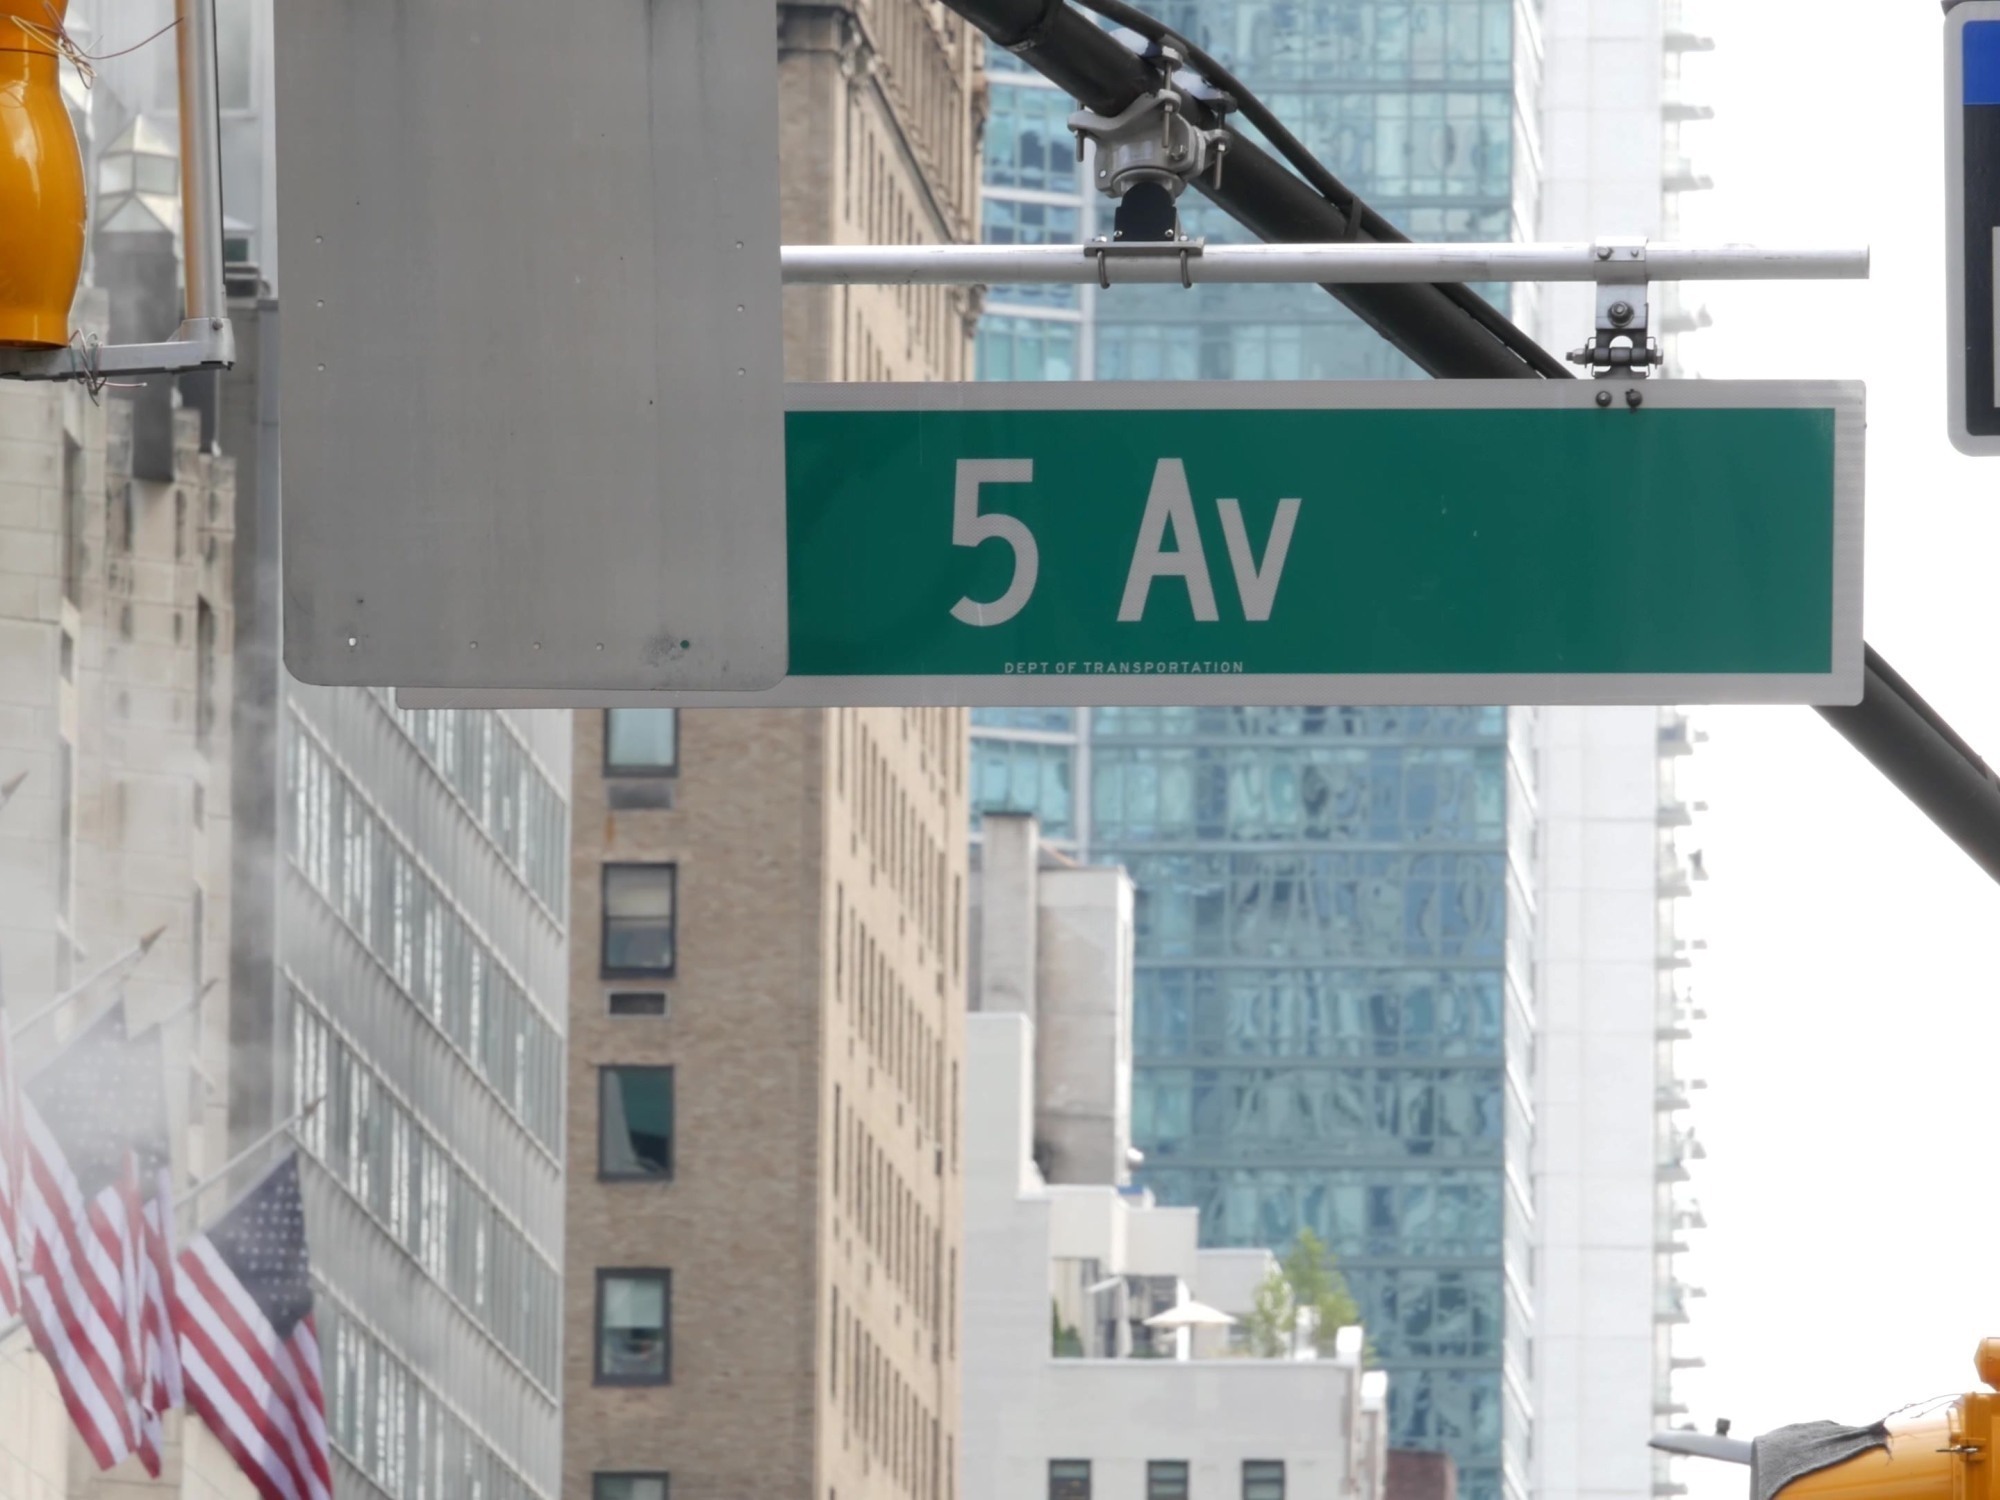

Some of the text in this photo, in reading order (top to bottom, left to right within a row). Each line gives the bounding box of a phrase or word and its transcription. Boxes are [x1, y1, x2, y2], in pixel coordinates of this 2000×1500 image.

[949, 457, 1303, 627] 5 Av
[1004, 661, 1244, 674] DEPT OF TRANSPORTATION
